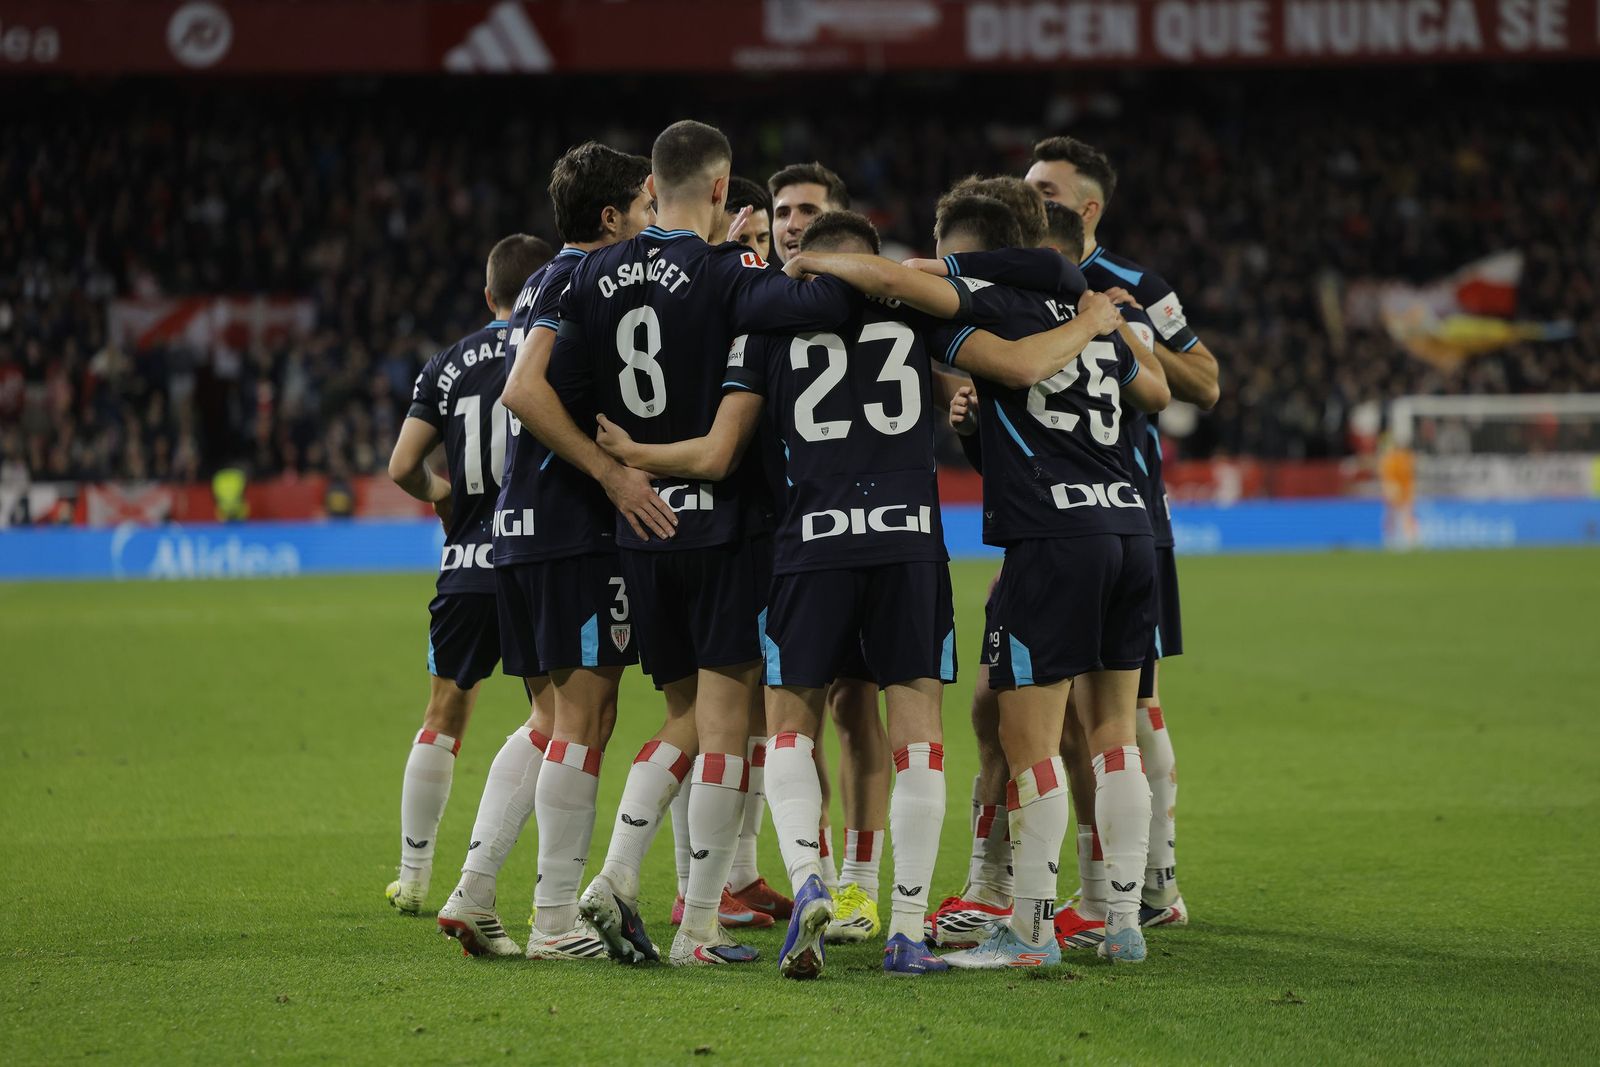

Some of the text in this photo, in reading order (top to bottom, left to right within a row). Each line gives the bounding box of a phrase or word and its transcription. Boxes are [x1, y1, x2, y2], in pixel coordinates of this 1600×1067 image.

[964, 1, 1138, 60] DICEN
[1152, 0, 1269, 62] QUE
[1284, 0, 1484, 55] NUNCA
[1496, 0, 1568, 52] SE
[616, 305, 667, 419] 8
[790, 321, 922, 442] 23
[1027, 341, 1121, 446] 25
[652, 482, 714, 513] GI
[1050, 482, 1146, 510] DIG
[492, 508, 534, 537] IGI
[802, 504, 932, 542] DIGI
[608, 576, 630, 622] 3
[1032, 900, 1042, 944] TAPEDESIGN
